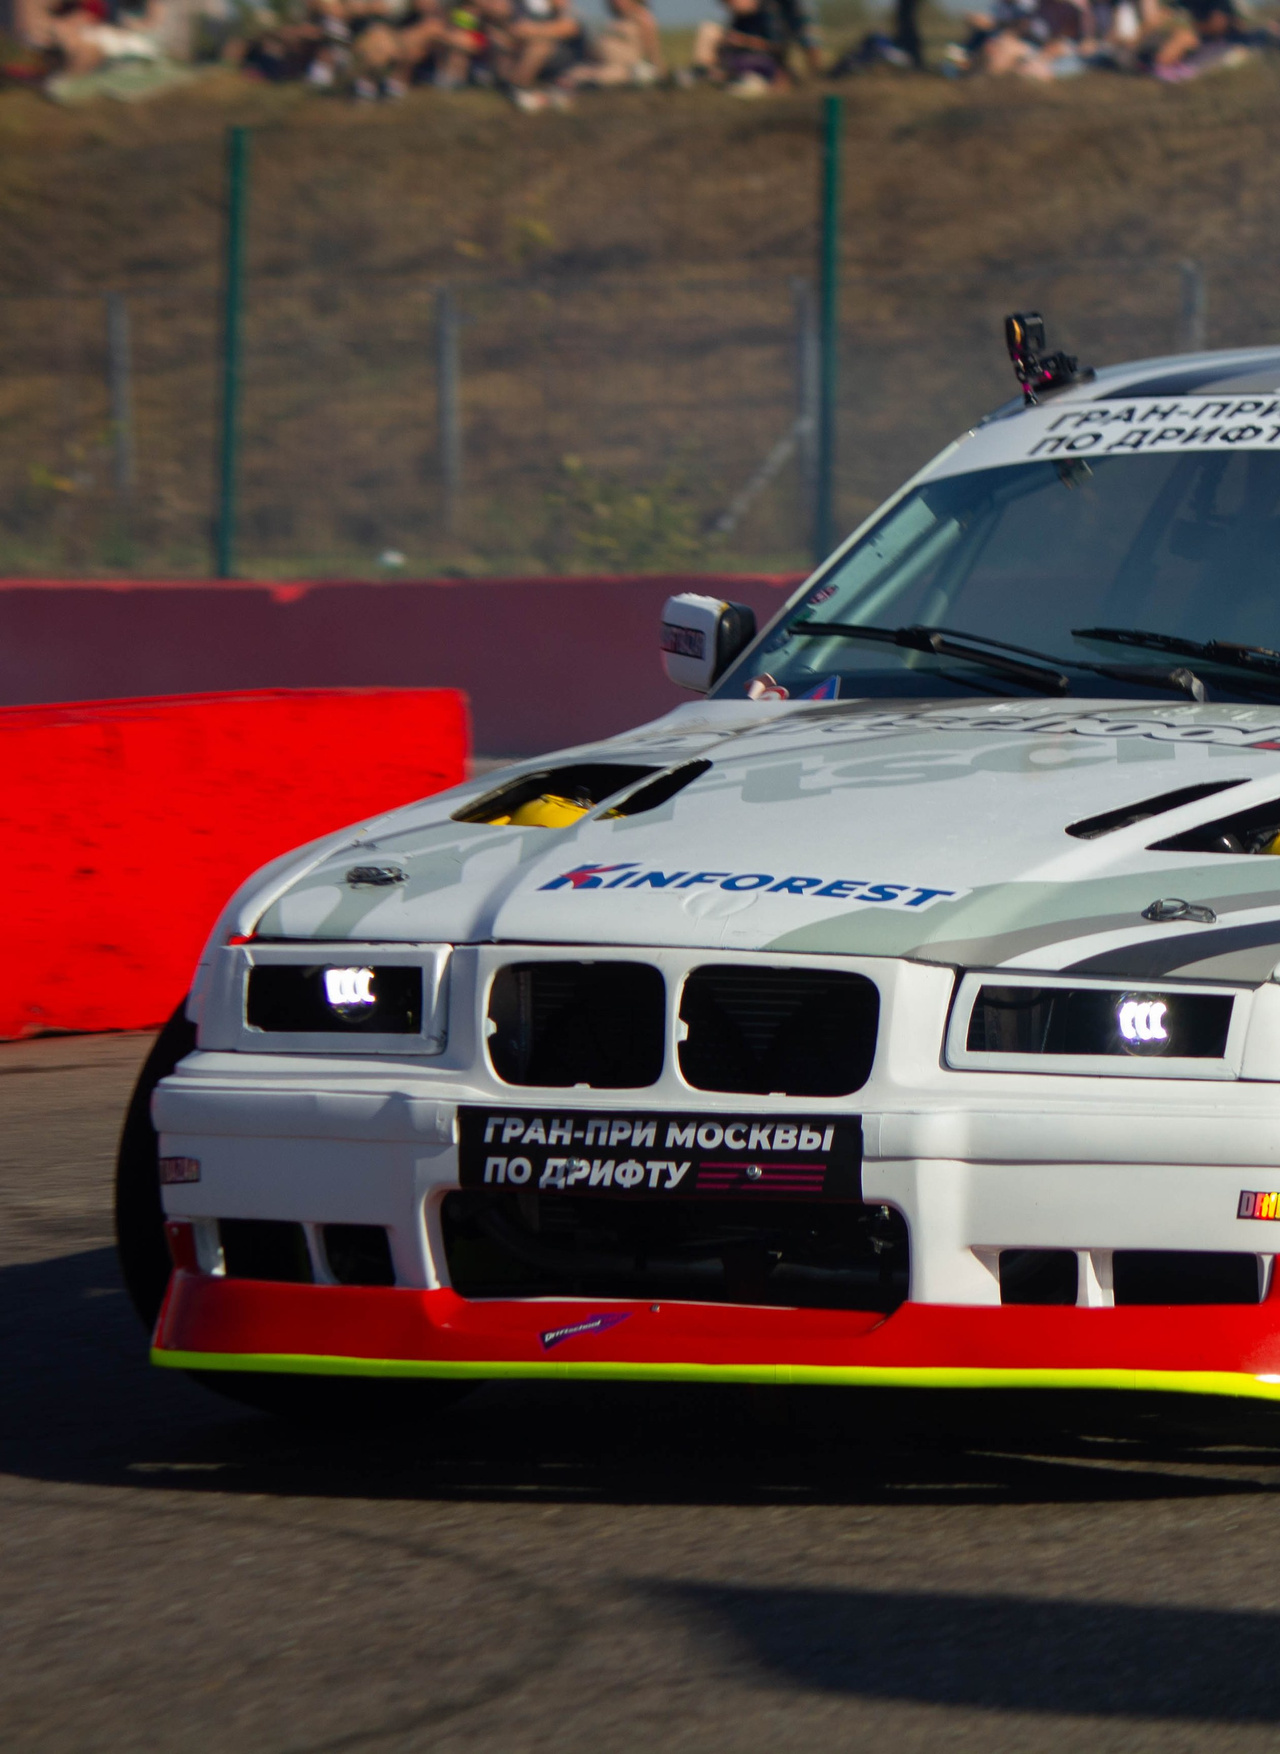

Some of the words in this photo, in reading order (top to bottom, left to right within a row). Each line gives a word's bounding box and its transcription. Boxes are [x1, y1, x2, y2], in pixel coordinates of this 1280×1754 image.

[1029, 432, 1103, 456] ПО
[537, 863, 957, 908] KINFOREST
[484, 1117, 658, 1148] ГРАН-ПРИ
[664, 1122, 836, 1152] МОСКВЫ
[484, 1156, 532, 1185] ПО
[539, 1158, 692, 1190] ДРИФТУ
